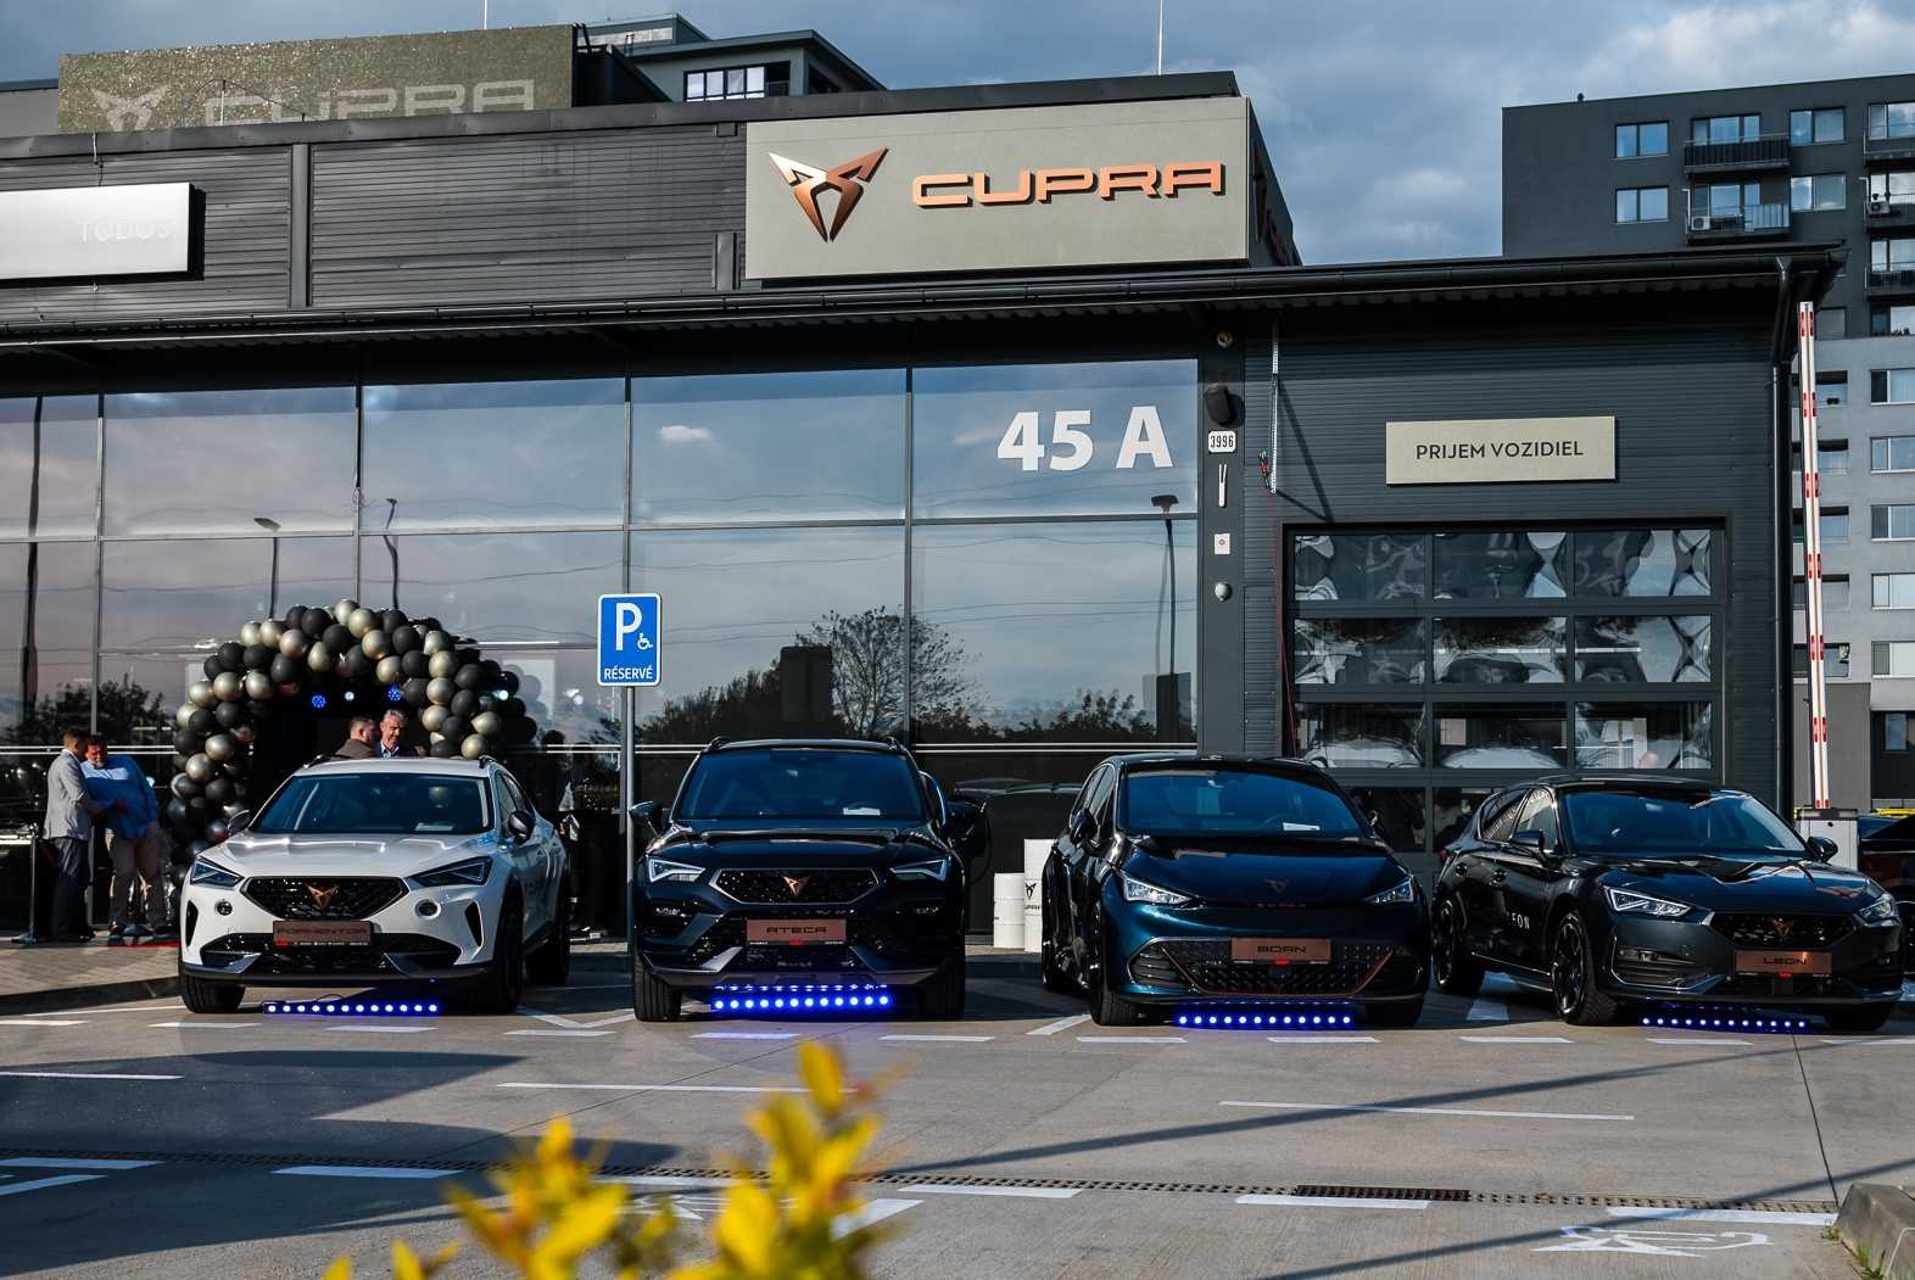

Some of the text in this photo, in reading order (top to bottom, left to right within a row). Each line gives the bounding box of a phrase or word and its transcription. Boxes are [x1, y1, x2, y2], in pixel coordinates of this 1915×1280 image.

[912, 160, 1223, 207] CUPRA
[998, 406, 1173, 471] 45 A
[1210, 435, 1234, 448] 3996
[1416, 441, 1584, 460] PRIJEM VOZIDIEL
[615, 602, 642, 652] P
[604, 664, 654, 680] RÉSERVÉ
